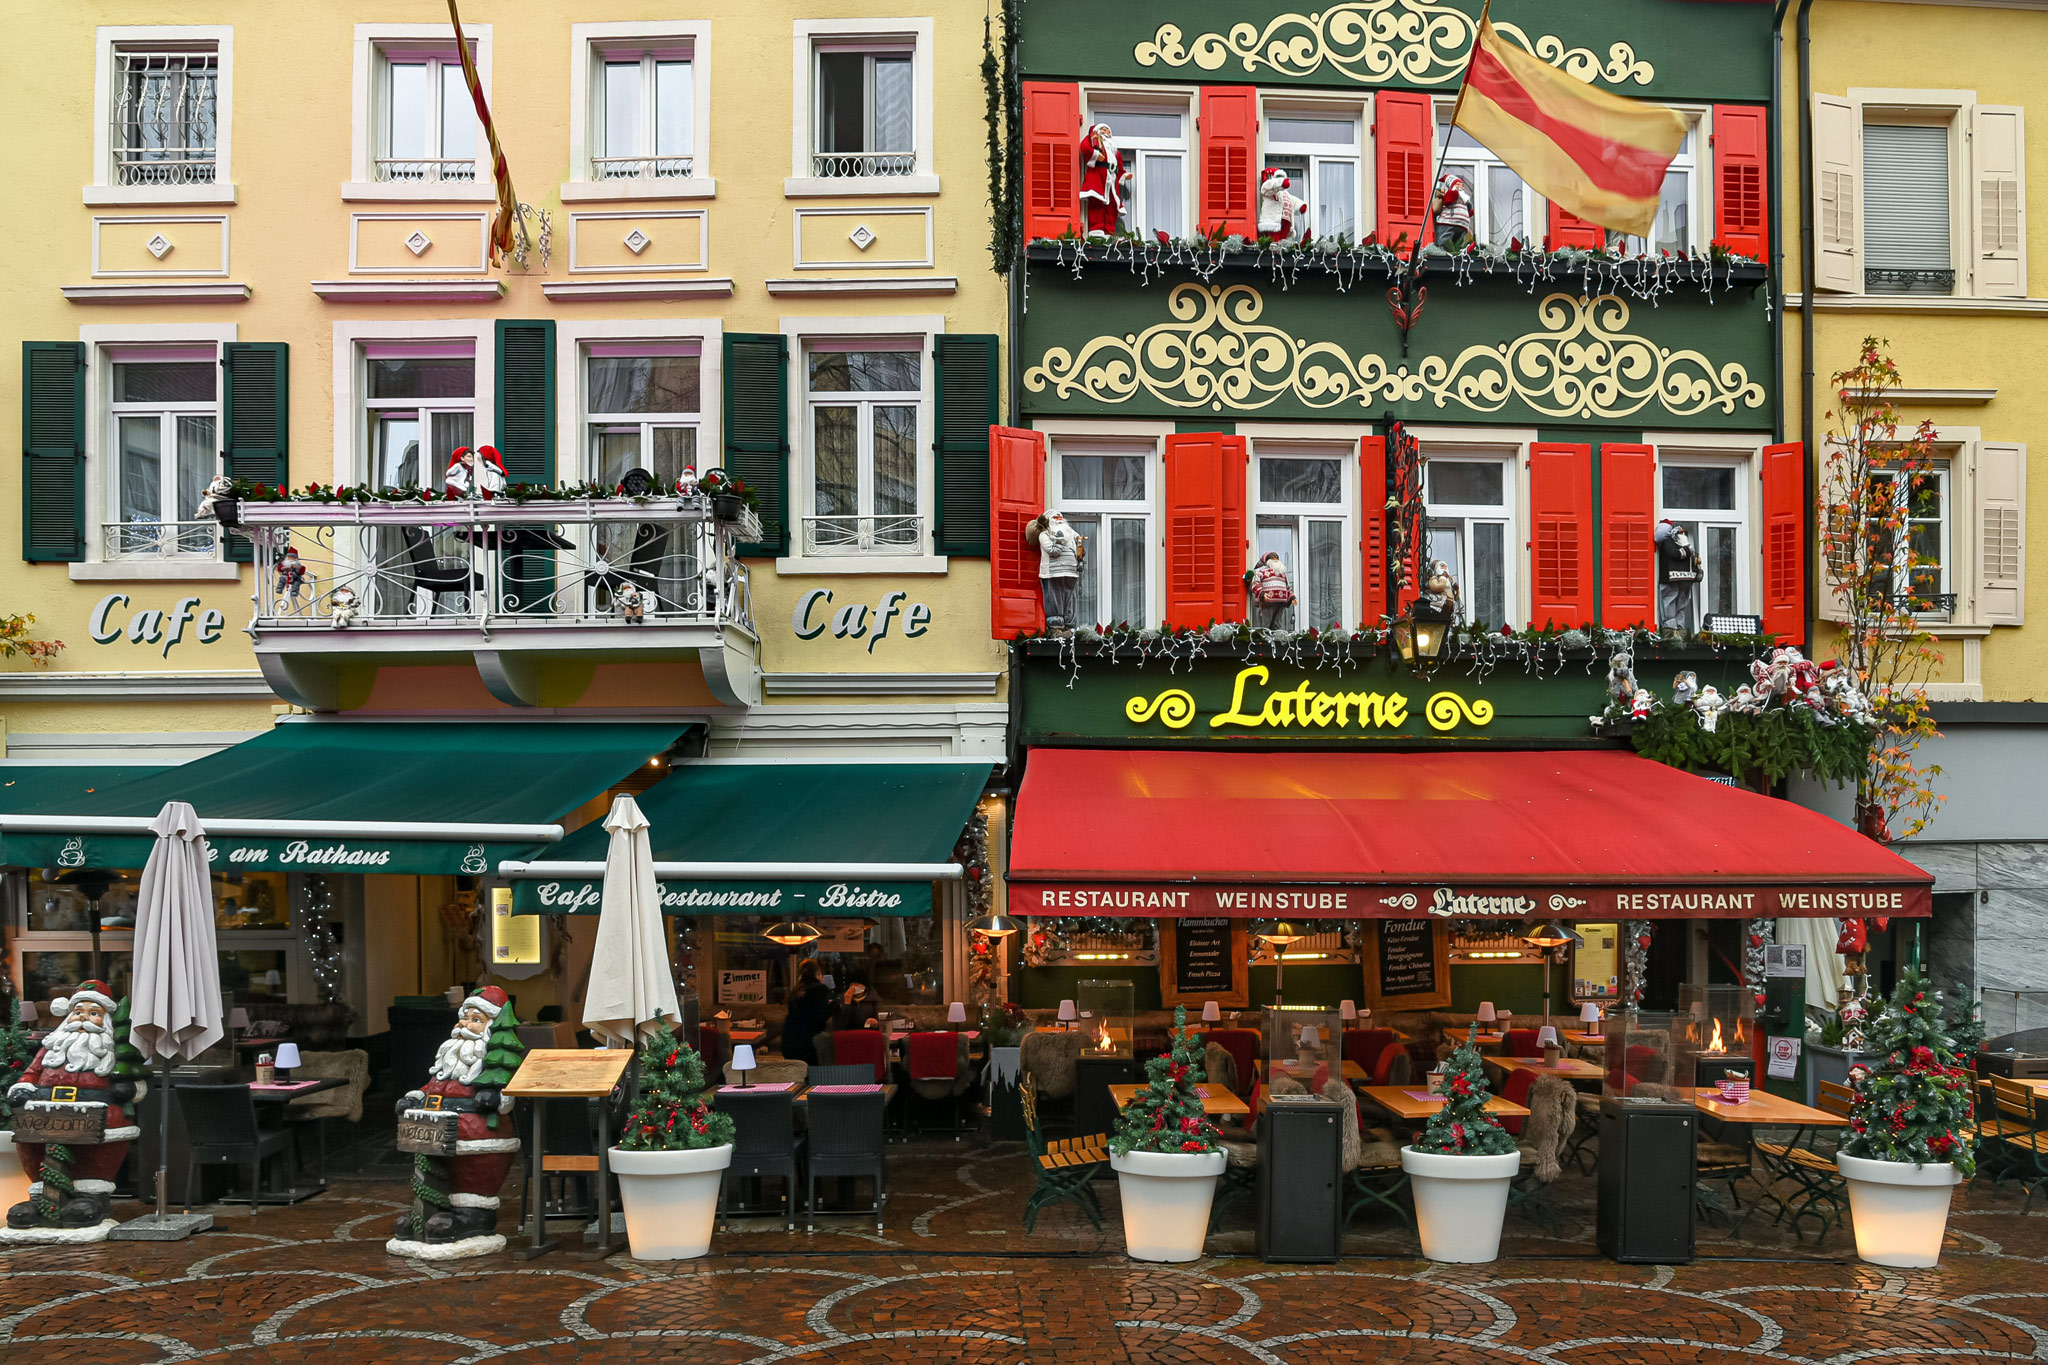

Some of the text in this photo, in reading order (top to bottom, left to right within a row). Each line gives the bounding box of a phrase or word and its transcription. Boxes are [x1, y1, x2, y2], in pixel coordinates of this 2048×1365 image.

[89, 594, 225, 660] Cafe
[792, 588, 932, 655] Cafe
[1209, 665, 1409, 728] Laterne
[229, 846, 269, 863] am
[279, 840, 391, 866] Rathaus
[537, 882, 601, 914] Cafe
[818, 883, 902, 909] Bistro
[1042, 888, 1904, 917] RESTAURANT WEINSTUBE Laterne RESTAURANT WEINSTUBE
[1980, 891, 1989, 904] 8
[1384, 919, 1426, 933] Fondue
[723, 973, 760, 984] Zimmer
